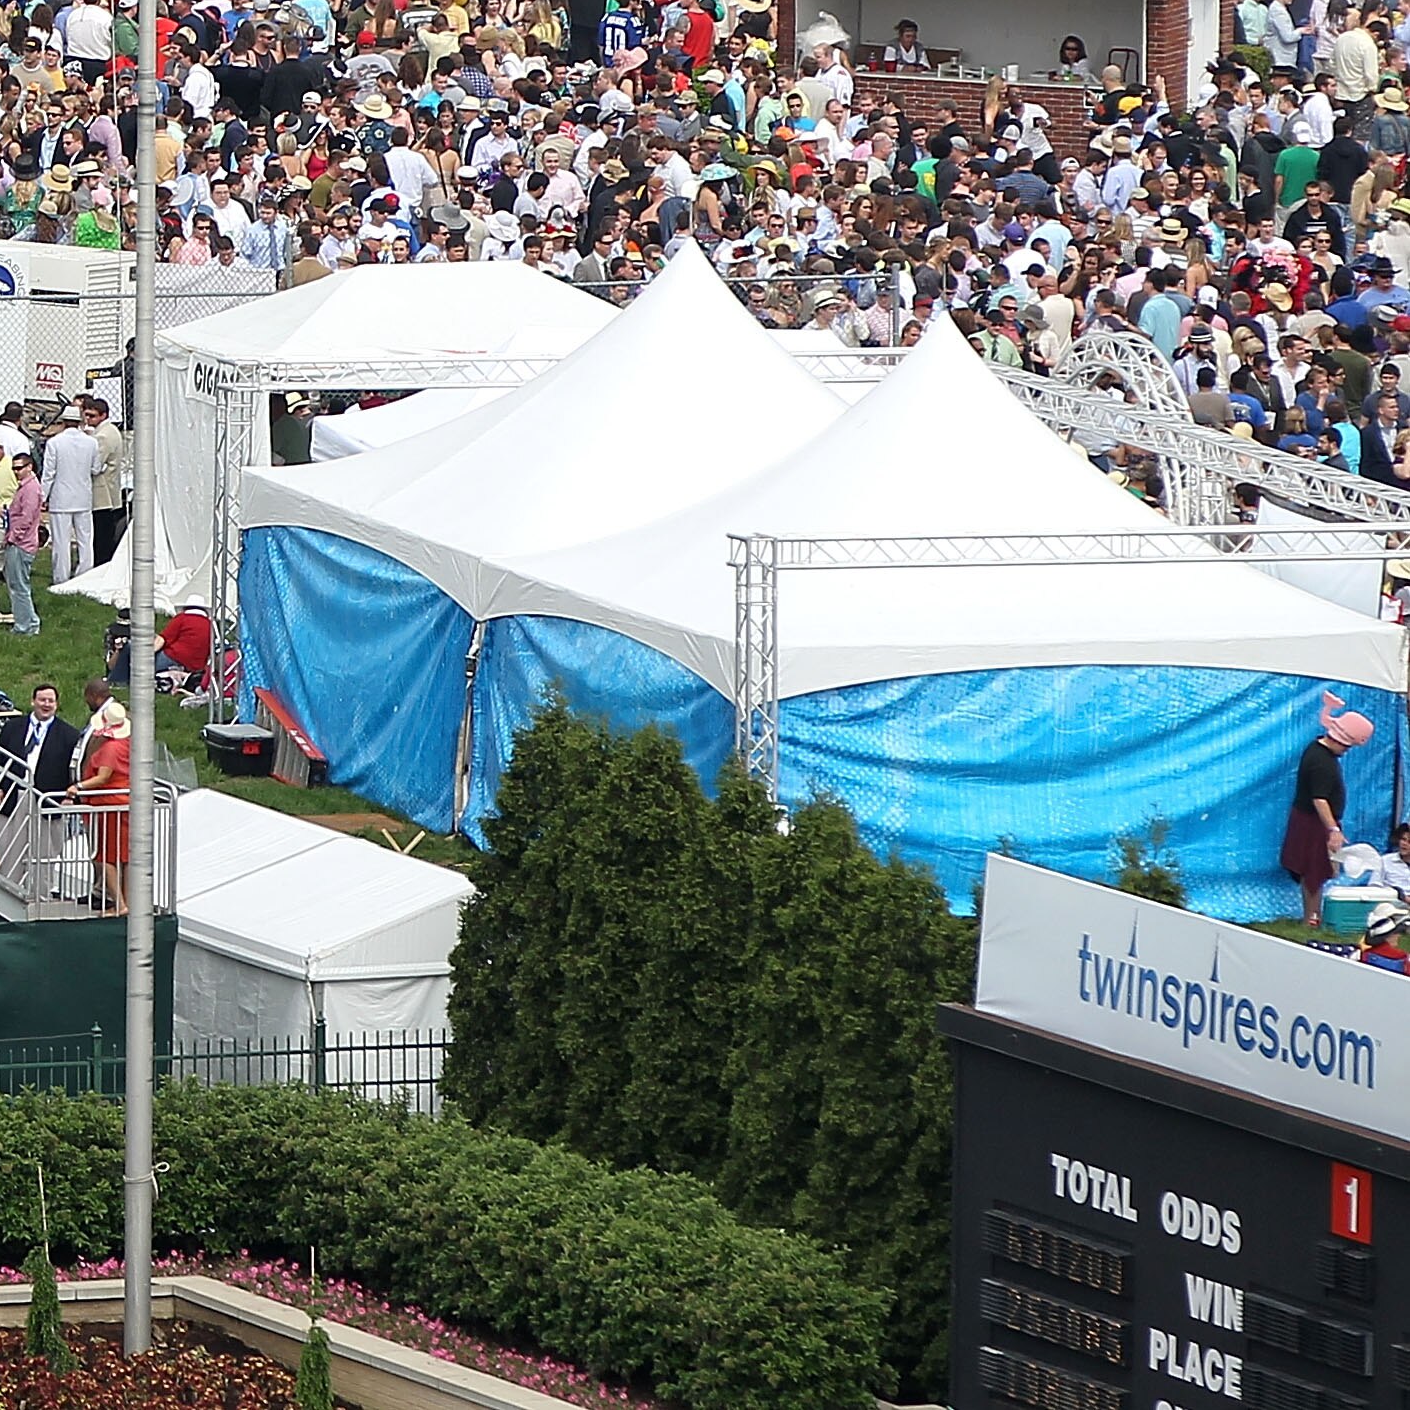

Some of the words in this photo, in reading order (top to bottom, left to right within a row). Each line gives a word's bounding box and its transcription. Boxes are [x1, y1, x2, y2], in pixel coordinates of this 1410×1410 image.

[36, 364, 63, 381] MQ
[1077, 910, 1376, 1090] twinspires.com
[1051, 1152, 1139, 1223] TOTAL
[1161, 1191, 1242, 1255] ODDS
[1344, 1176, 1359, 1234] 1
[1184, 1272, 1244, 1333] WIN
[1148, 1327, 1244, 1401] PLACE
